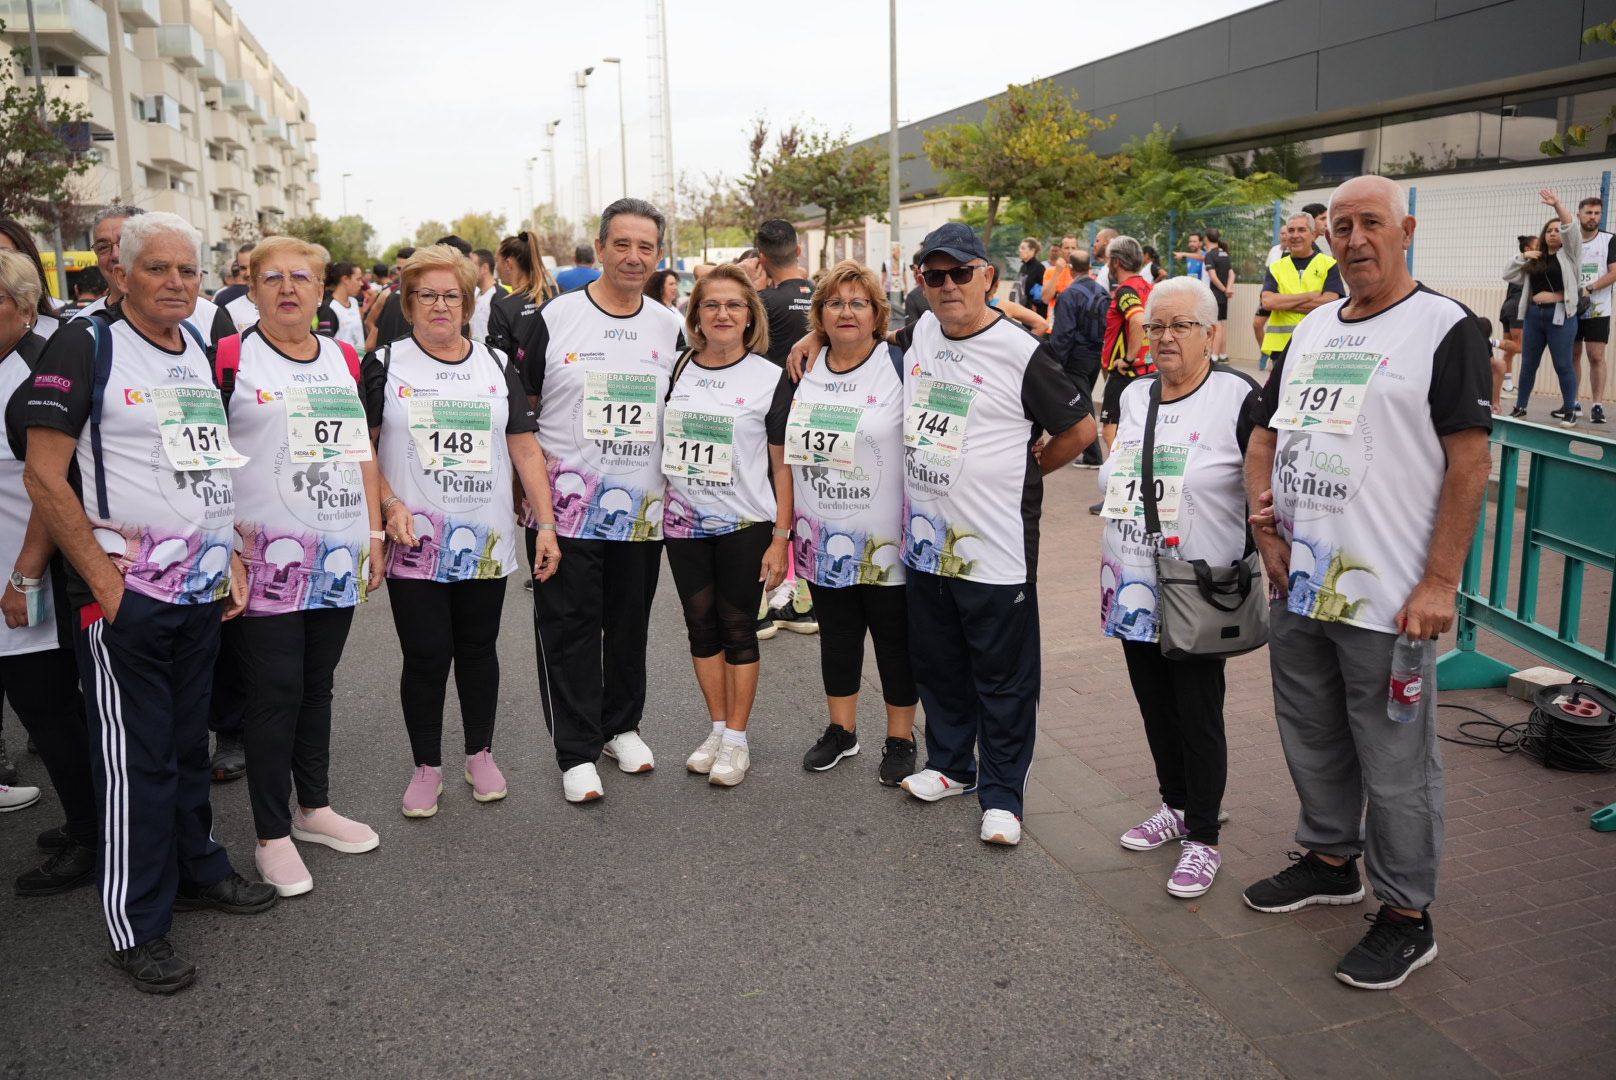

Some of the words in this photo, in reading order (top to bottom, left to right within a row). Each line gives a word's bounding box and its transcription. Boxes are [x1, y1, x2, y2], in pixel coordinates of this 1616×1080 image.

[603, 328, 638, 341] JOYLU
[1324, 335, 1367, 349] JOYLU
[1337, 352, 1380, 361] POPULAR
[435, 372, 471, 381] JOYLU
[625, 375, 657, 383] POPULAR
[695, 379, 726, 389] JOYLU
[824, 381, 857, 393] JOYLU
[945, 384, 977, 397] POPULAR
[452, 401, 490, 409] POPULAR
[1299, 386, 1343, 412] 191
[602, 403, 642, 425] 112
[699, 413, 735, 425] POPULAR
[830, 405, 862, 415] POPULAR
[314, 420, 343, 444] 67
[916, 411, 950, 437] 144
[183, 426, 221, 452] 151
[429, 431, 474, 454] 148
[801, 430, 840, 453] 137
[1357, 414, 1374, 462] CIUDAD
[601, 440, 650, 457] Peñas
[679, 441, 714, 465] 111
[1310, 450, 1343, 471] 100
[907, 459, 950, 487] Peñas
[442, 475, 492, 493] Peñas
[817, 482, 871, 500] Peñas
[1283, 471, 1348, 501] Peñas
[317, 488, 362, 509] Peñas
